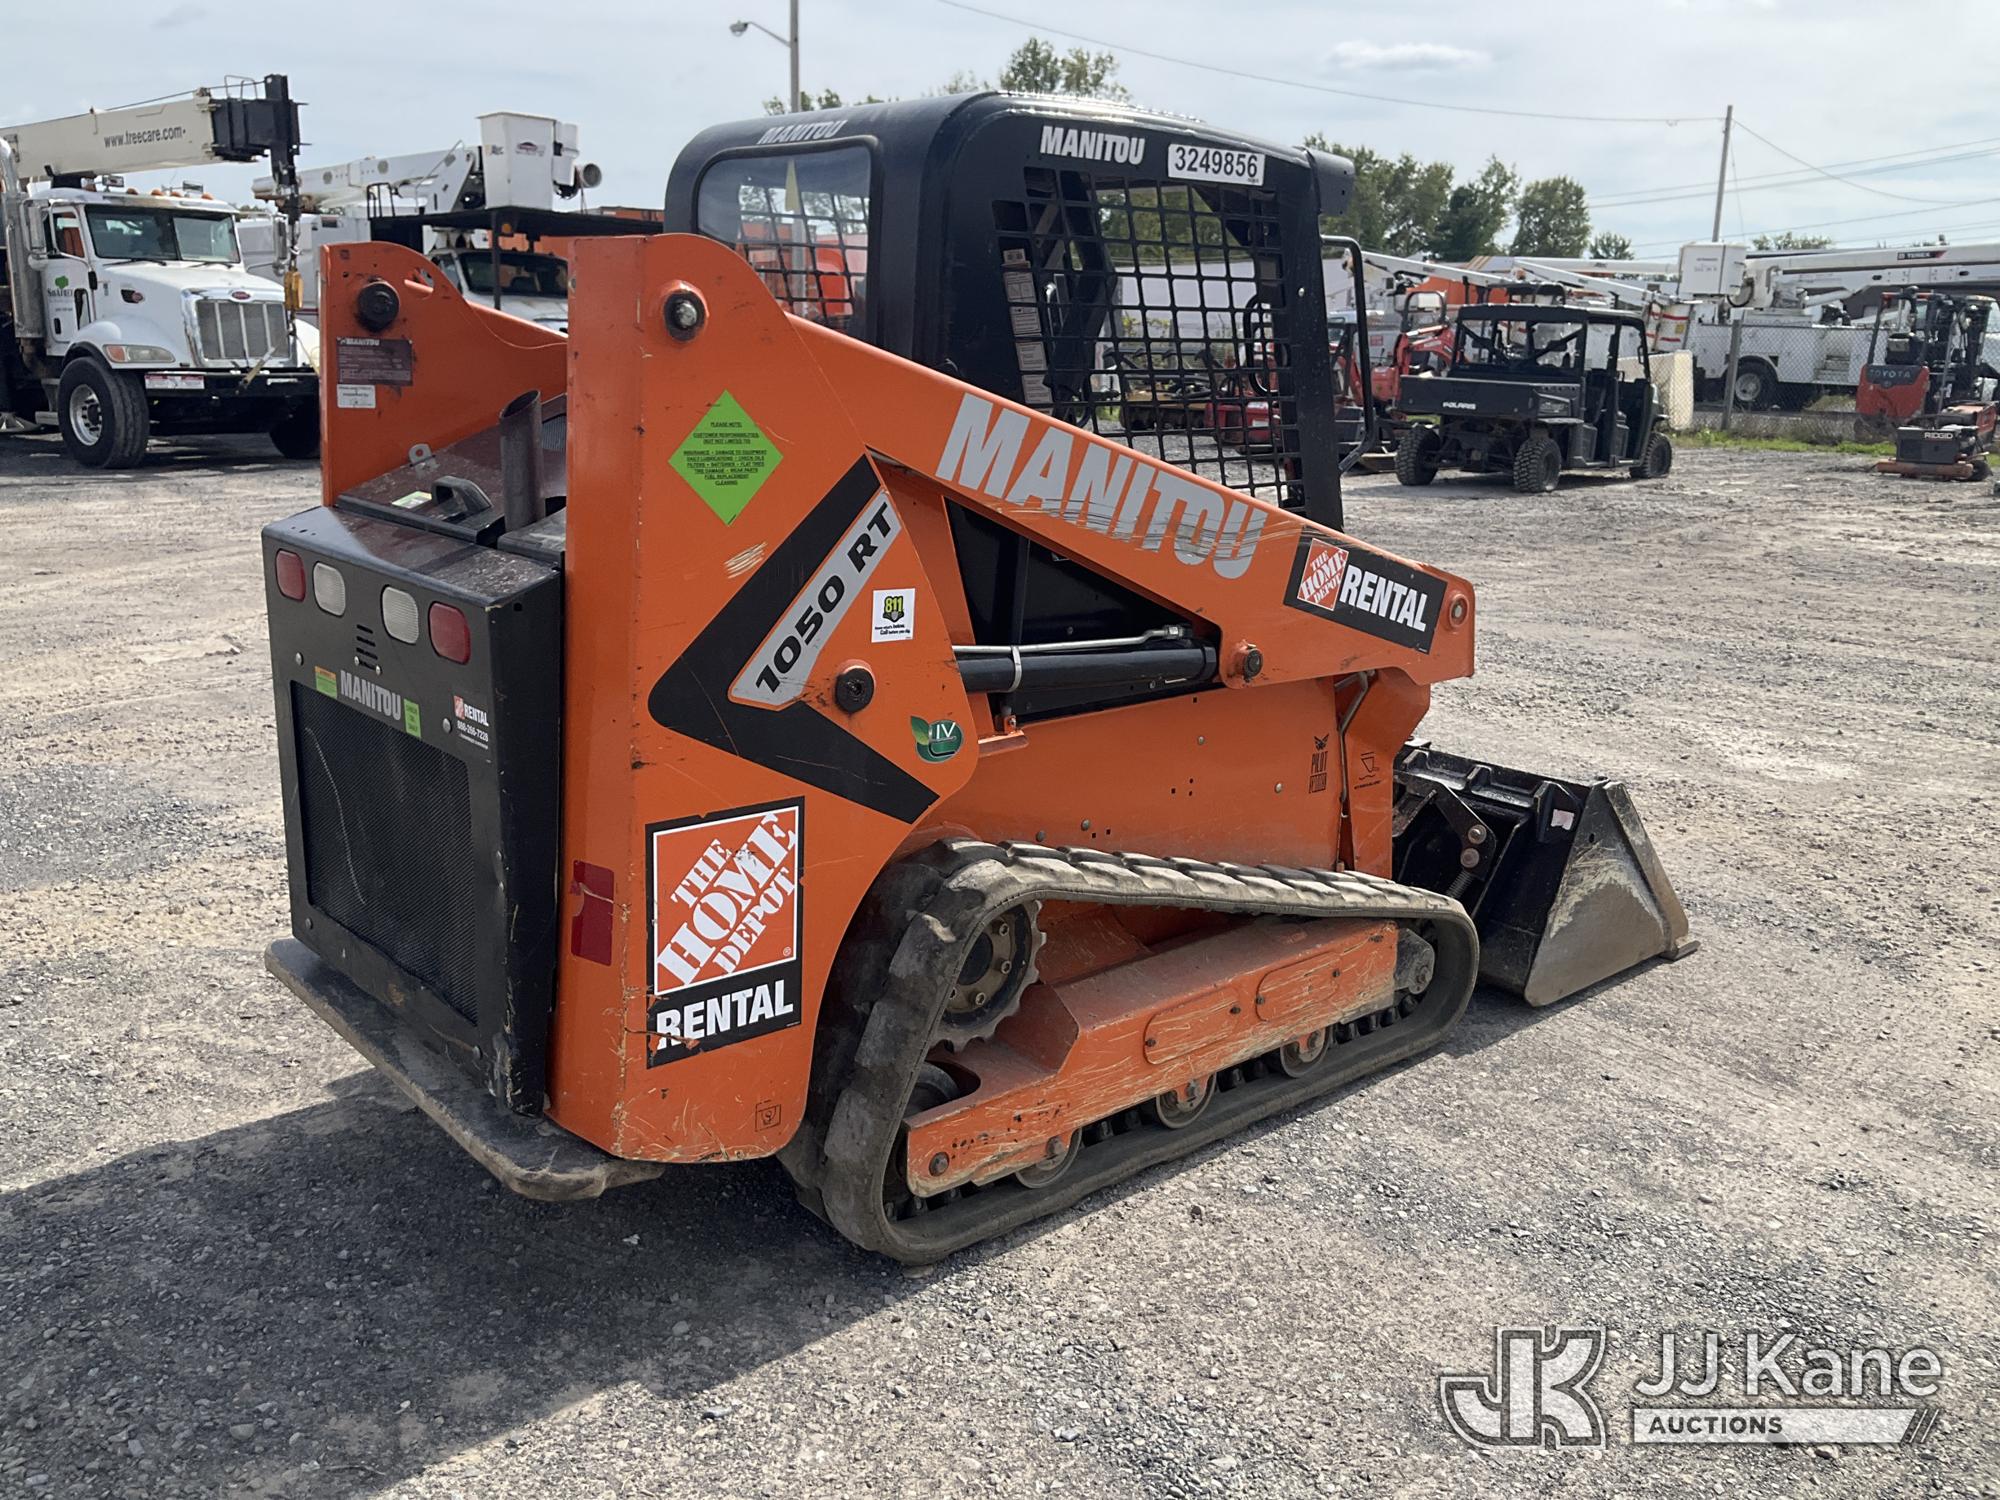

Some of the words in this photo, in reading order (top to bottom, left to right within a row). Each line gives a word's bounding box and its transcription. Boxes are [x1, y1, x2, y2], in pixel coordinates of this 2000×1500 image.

[103, 126, 183, 148] www.treecare.com
[757, 119, 848, 145] MANITOU
[1040, 126, 1145, 166] MANITOU
[1174, 146, 1258, 178] 3249856
[346, 337, 380, 346] MANITOU
[1869, 368, 1912, 379] TOYOTA
[1442, 401, 1477, 411] POLARIS
[1924, 431, 1954, 440] RIDGID
[935, 392, 1268, 580] MANITOU
[1300, 548, 1346, 600] HOME
[1310, 550, 1329, 571] THE
[755, 574, 844, 693] 1050
[848, 501, 891, 573] RT
[884, 596, 904, 613] 811
[1339, 564, 1428, 632] RENTAL
[340, 669, 402, 721] MANITOU
[463, 703, 490, 727] RENTAL
[936, 721, 957, 740] IV
[1311, 750, 1329, 776] PILOT
[669, 838, 733, 909] THE
[656, 812, 798, 987] HOME
[712, 866, 796, 975] DEPOT
[656, 979, 794, 1051] RENTAL
